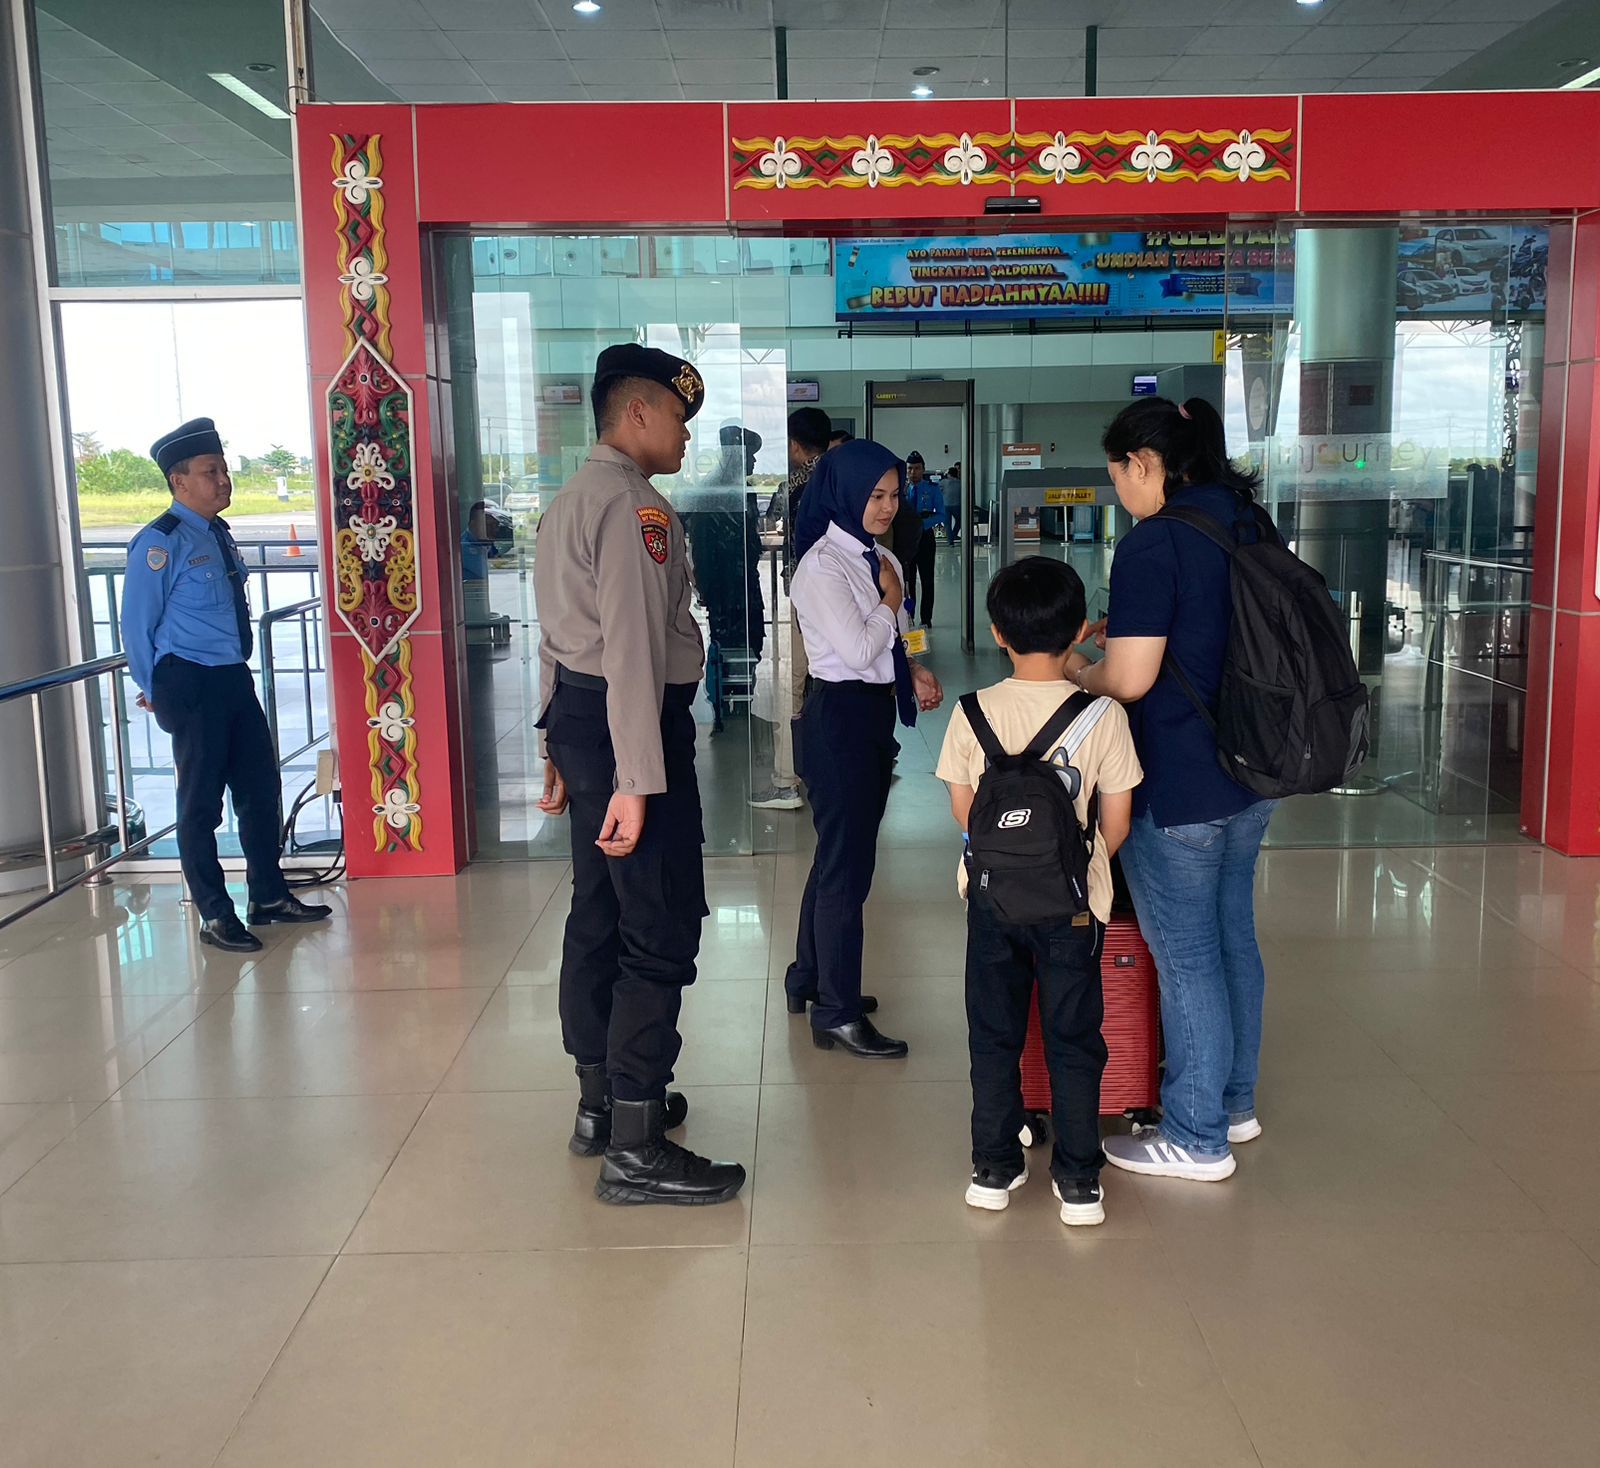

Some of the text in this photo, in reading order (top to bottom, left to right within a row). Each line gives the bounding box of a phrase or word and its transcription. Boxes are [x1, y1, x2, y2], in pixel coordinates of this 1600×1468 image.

[907, 249, 928, 258] AYO
[1097, 251, 1169, 268] UNDIAN
[871, 286, 933, 305] REBUT
